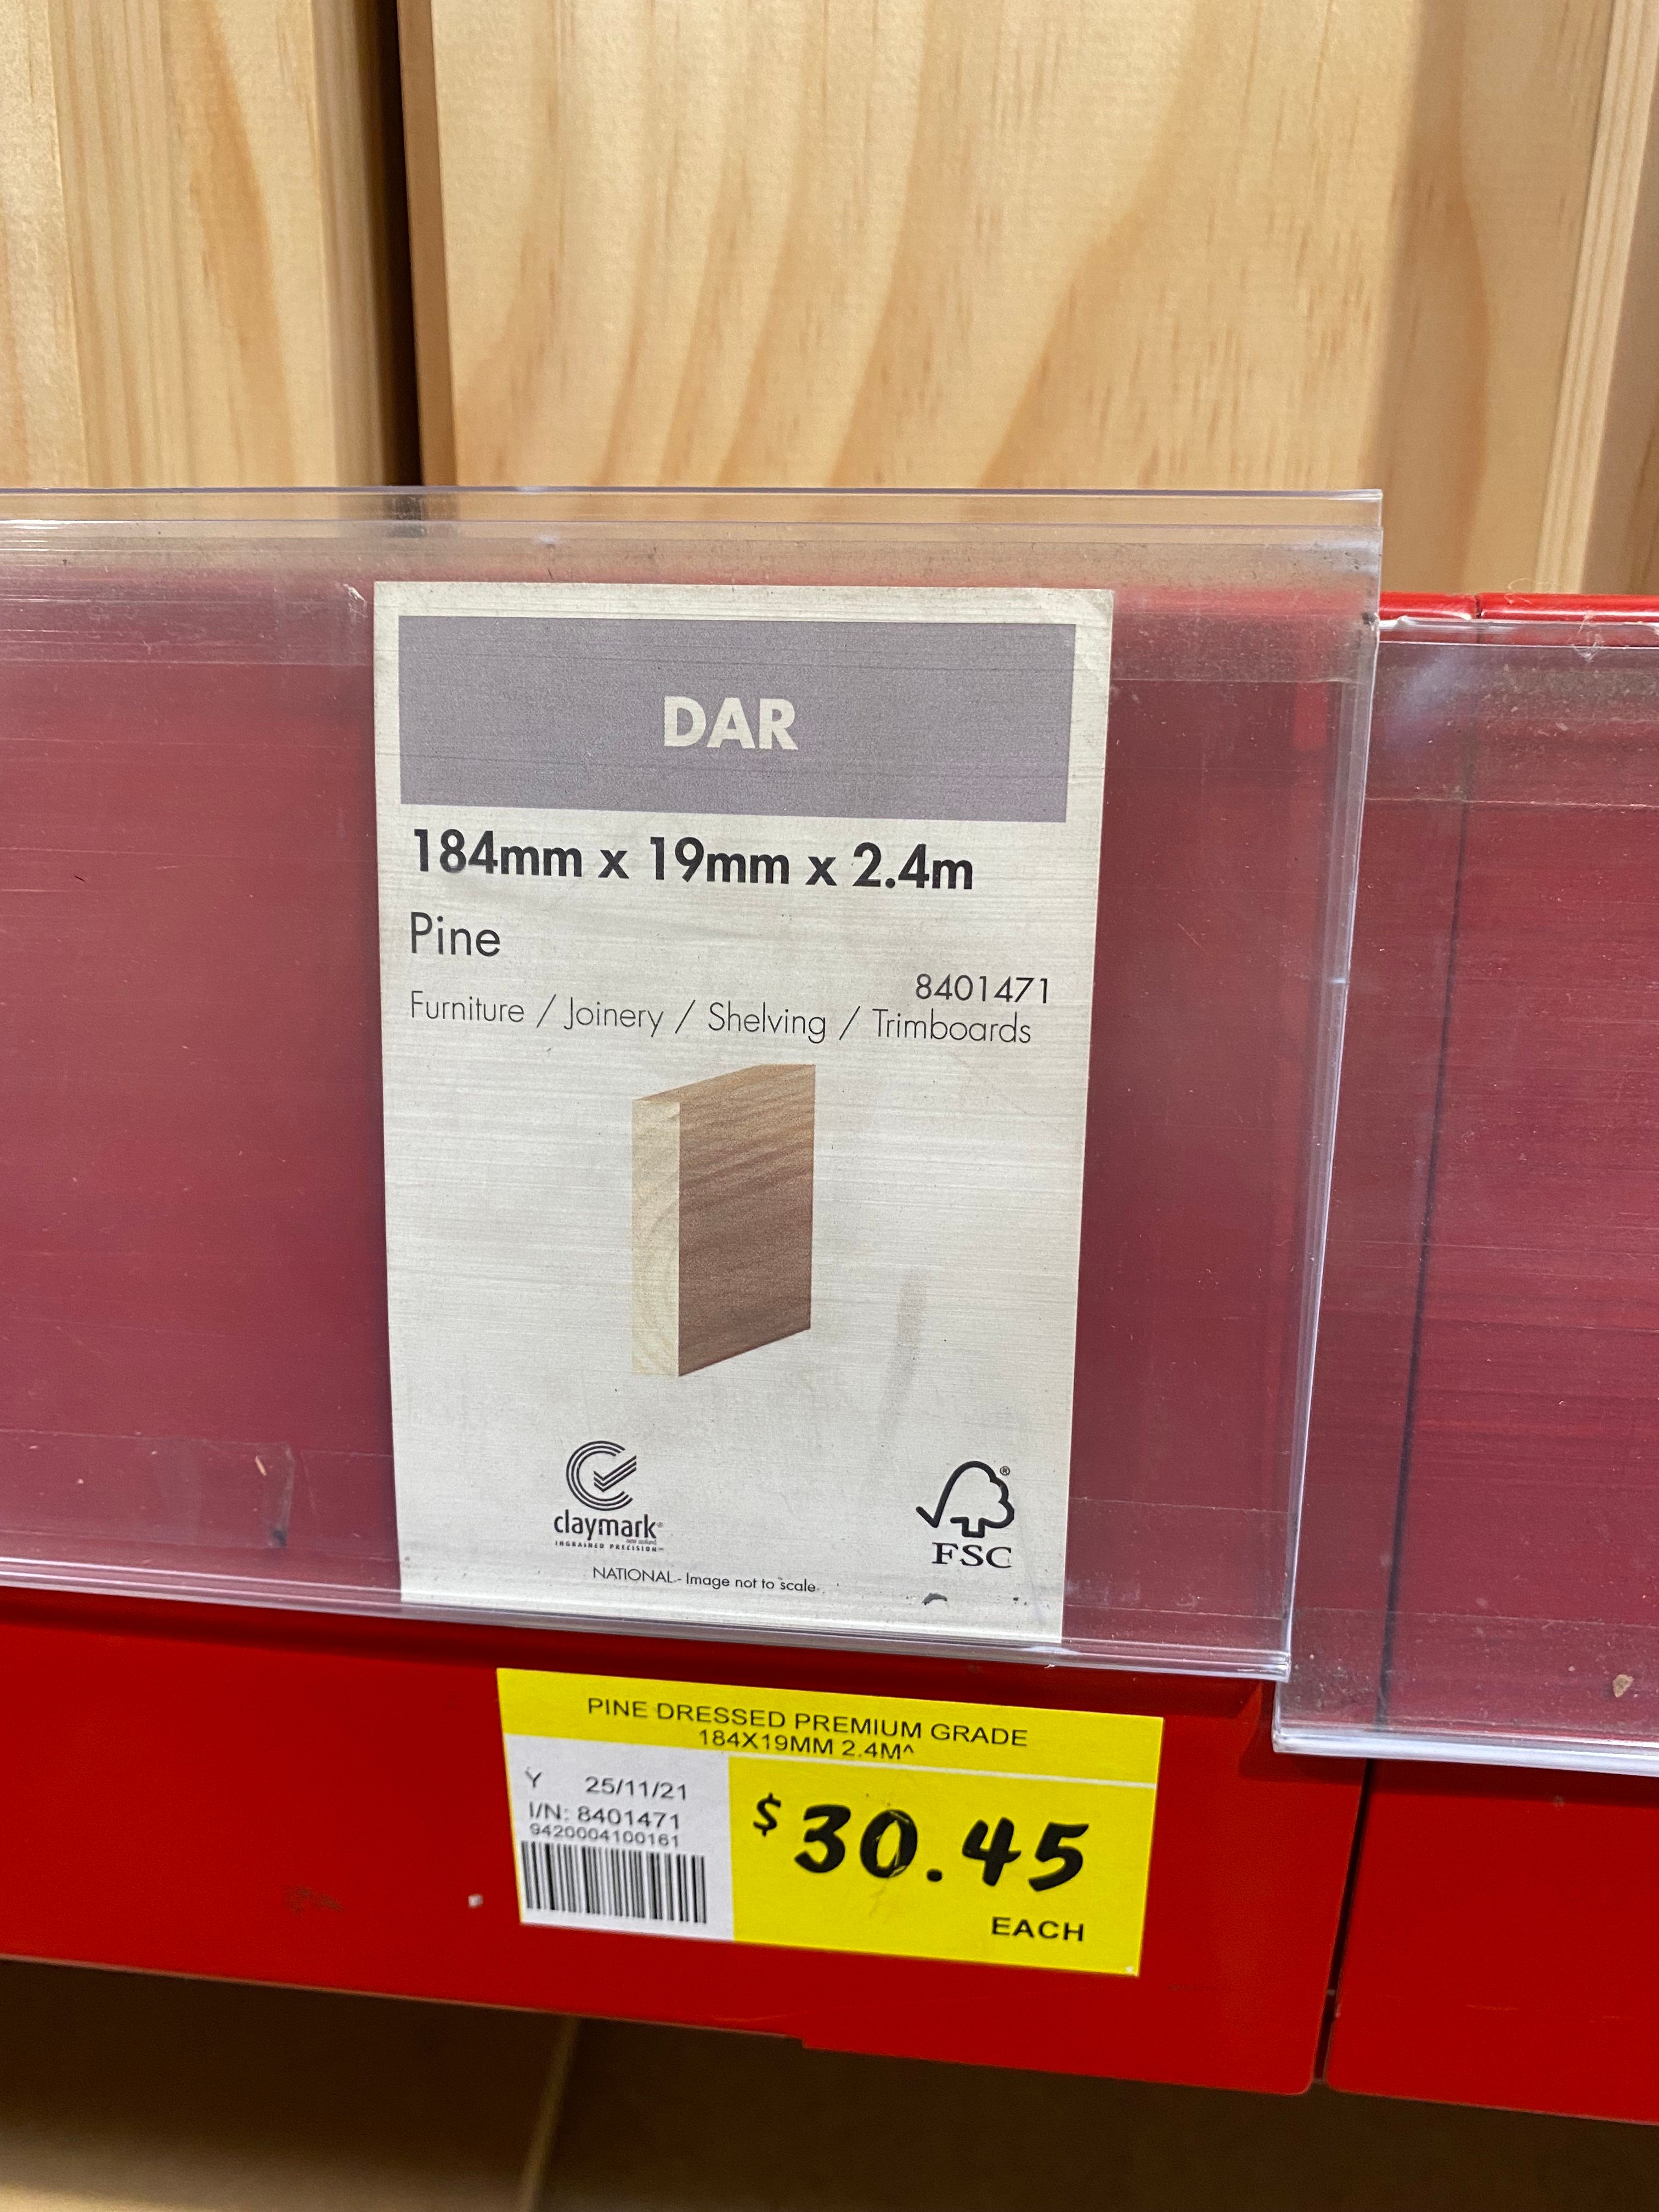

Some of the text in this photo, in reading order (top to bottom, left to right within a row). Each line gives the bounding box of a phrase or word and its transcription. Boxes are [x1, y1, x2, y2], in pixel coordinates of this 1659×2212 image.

[663, 695, 799, 751] DAR
[414, 828, 973, 890] 184mm x 19mm x 2.4m
[410, 911, 500, 957] Pine
[915, 973, 1049, 1004] 8401471
[410, 990, 1031, 1044] Furniture / Joinery / Shelving / Trimboards
[554, 1509, 657, 1541] claymark
[931, 1542, 1012, 1569] FSC
[686, 1572, 730, 1590] Image
[735, 1578, 757, 1589] not
[761, 1578, 775, 1590] to
[780, 1578, 816, 1592] scale
[588, 1697, 1028, 1747] PINE DRESSED PREMIUM GRADE
[699, 1728, 833, 1756] 184X19MM
[524, 1769, 687, 1801] Y 25/11/21
[528, 1801, 680, 1830] I/N: 8401471
[529, 1821, 680, 1849] 9420004100161
[991, 1915, 1085, 1943] EACH
